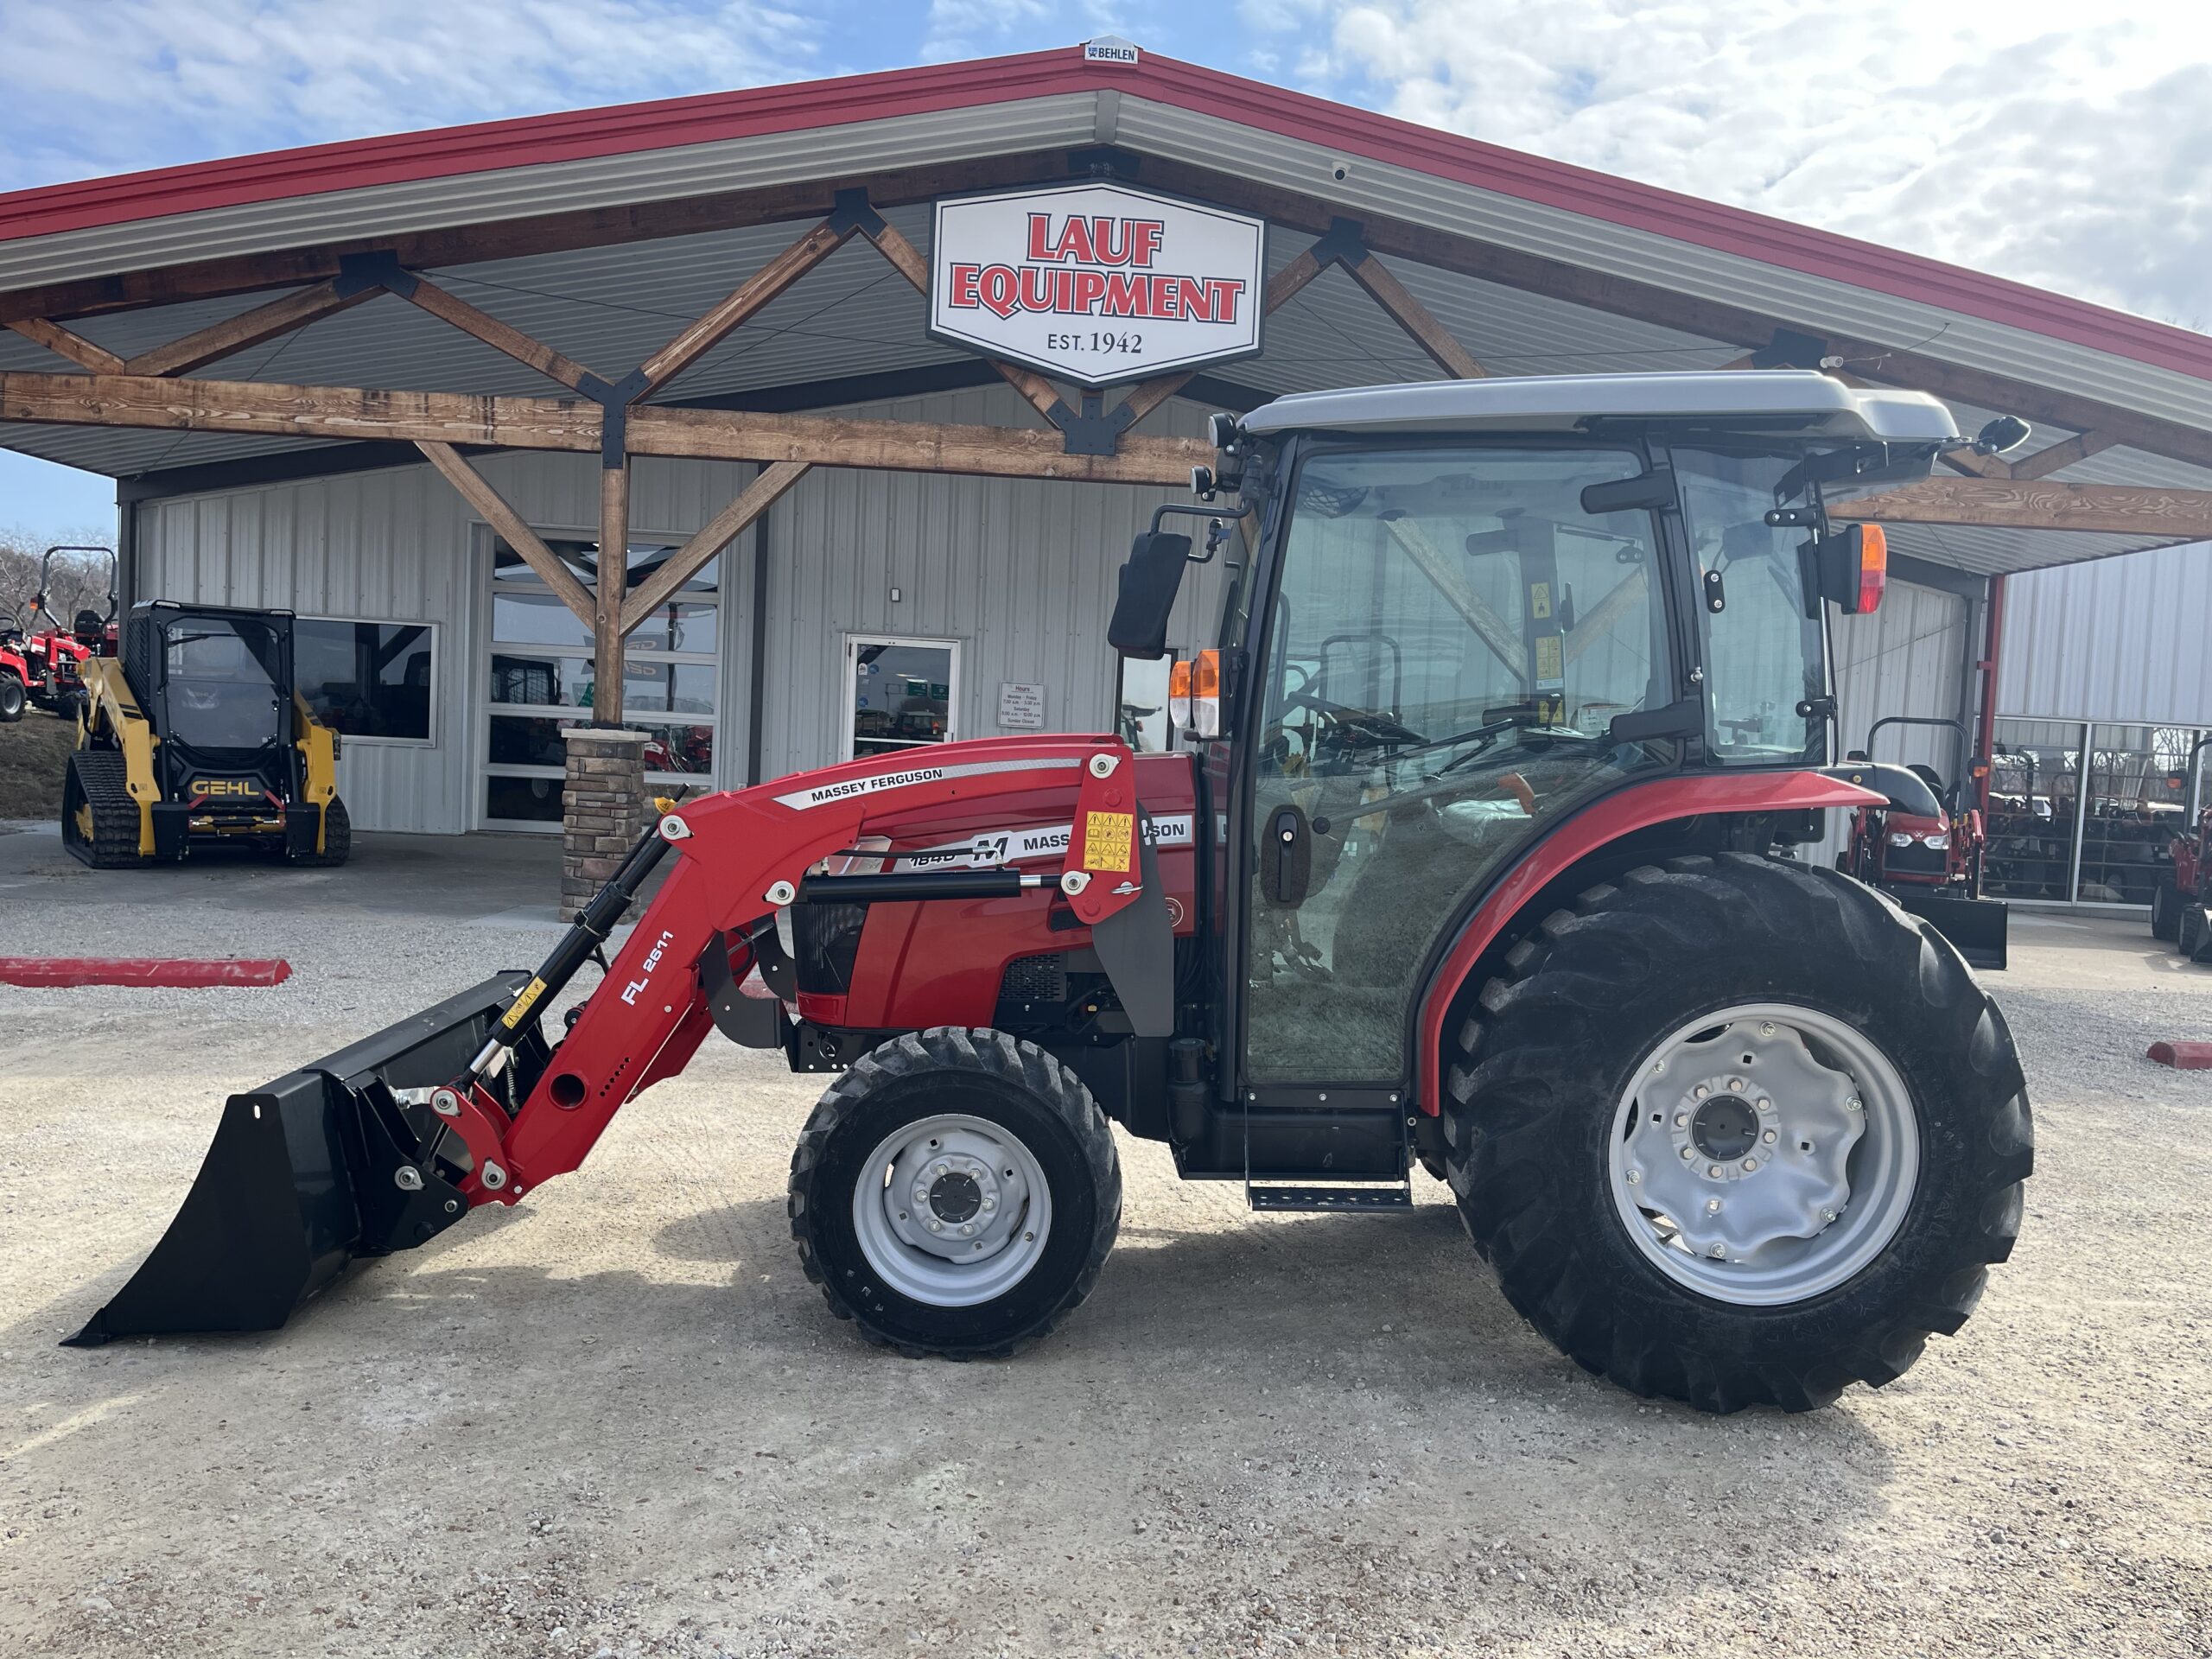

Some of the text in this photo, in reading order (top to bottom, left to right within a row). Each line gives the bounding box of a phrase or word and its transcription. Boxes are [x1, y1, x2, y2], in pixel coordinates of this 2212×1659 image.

[1098, 48, 1135, 60] BEHLEN
[1027, 213, 1165, 269] LAUF
[949, 263, 1246, 325] EQUIPMENT
[1047, 331, 1142, 354] EST. 1942
[191, 780, 260, 796] GEHL
[811, 769, 943, 802] MASSEY FERGUSON
[620, 930, 674, 1006] FL 2611
